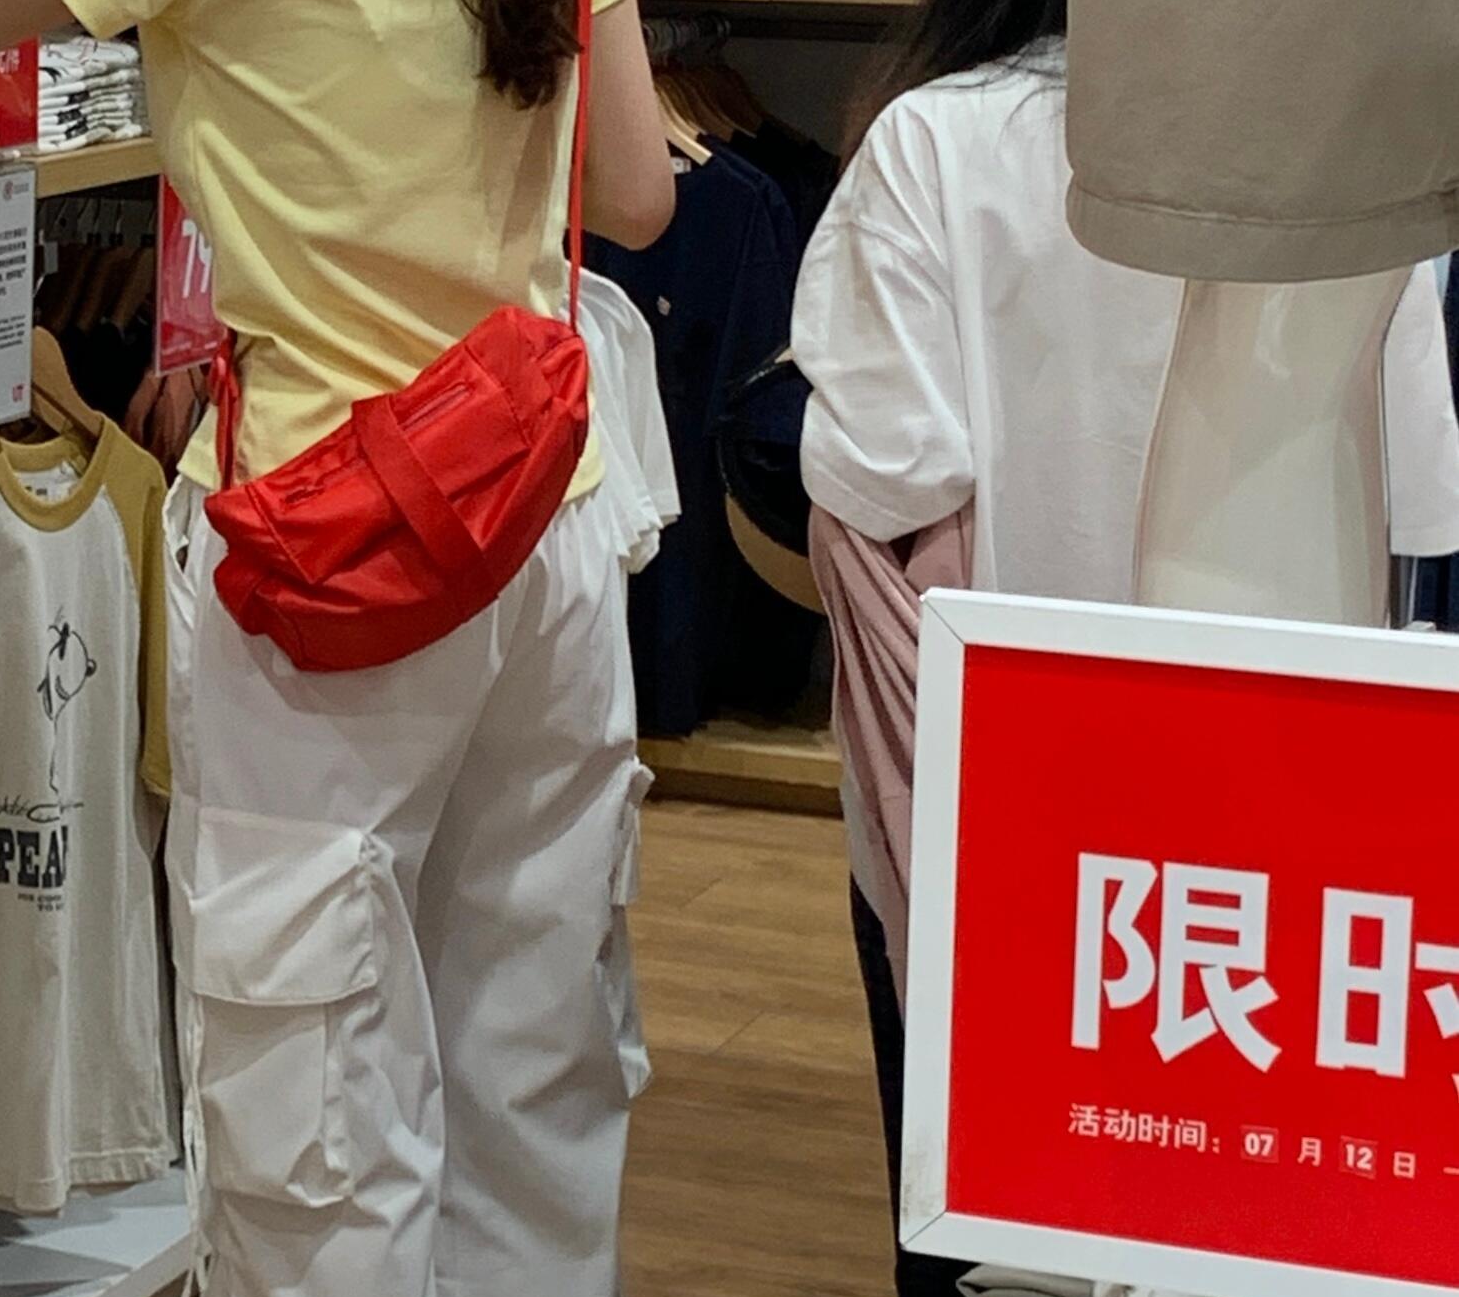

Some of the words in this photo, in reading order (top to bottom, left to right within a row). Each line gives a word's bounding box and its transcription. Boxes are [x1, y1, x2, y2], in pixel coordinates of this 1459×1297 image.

[1071, 851, 1459, 1093] 限时
[1244, 1132, 1274, 1156] 07
[1297, 1136, 1323, 1166] 月
[1345, 1143, 1375, 1170] 12
[1392, 1151, 1417, 1179] 日
